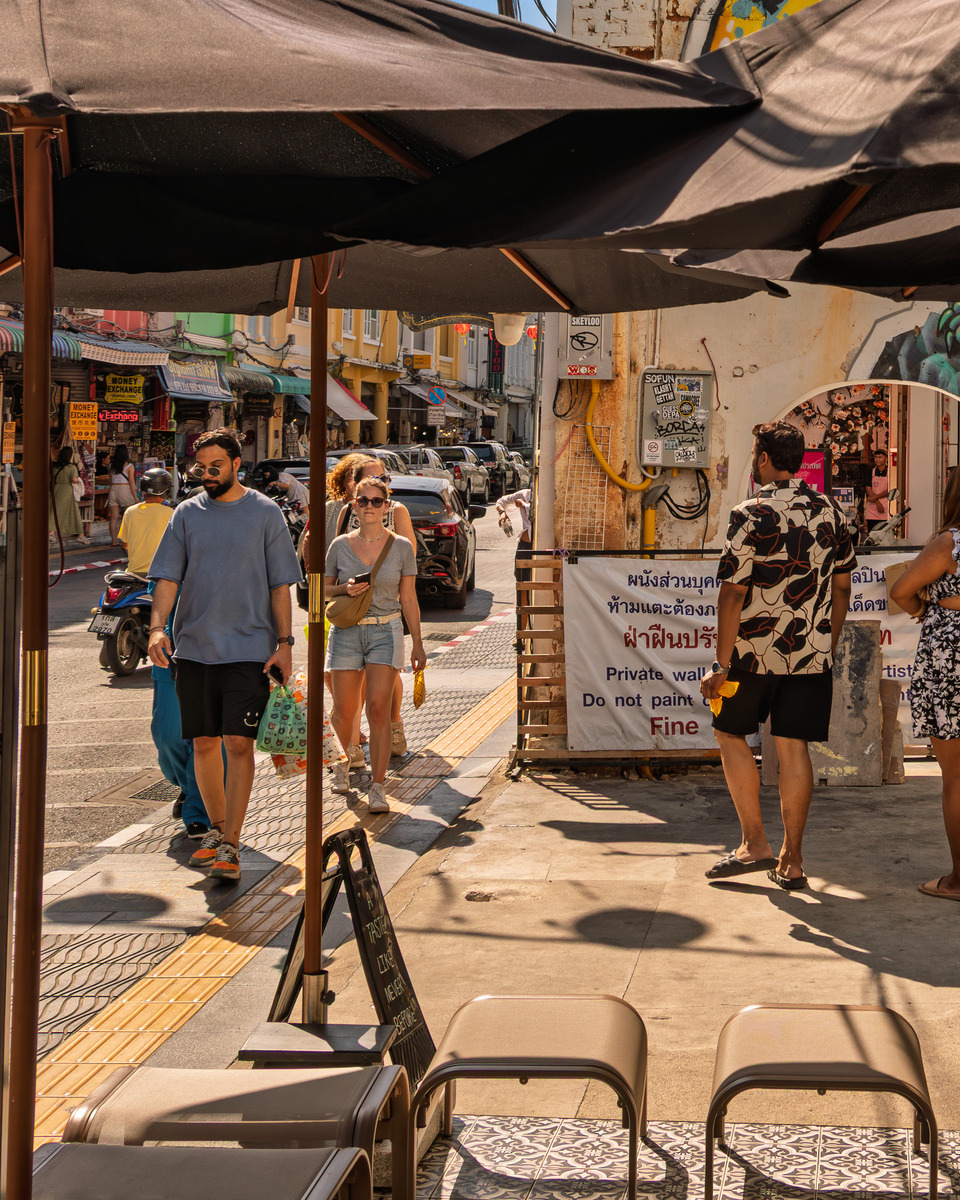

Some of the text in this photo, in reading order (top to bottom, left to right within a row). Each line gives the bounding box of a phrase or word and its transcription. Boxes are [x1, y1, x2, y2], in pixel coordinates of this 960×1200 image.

[493, 341, 501, 372] TTOO
[112, 376, 138, 385] MONEY
[107, 385, 142, 393] EXCHANGE
[73, 403, 95, 411] MONEY
[70, 411, 97, 419] EXCHANGE
[607, 593, 890, 616] ห้ามแตะต้องภ เด็ดข
[606, 667, 664, 681] Private
[672, 667, 706, 681] wall
[583, 693, 606, 707] Do
[615, 694, 642, 707] not
[651, 693, 694, 710] paint
[650, 717, 699, 736] Fine
